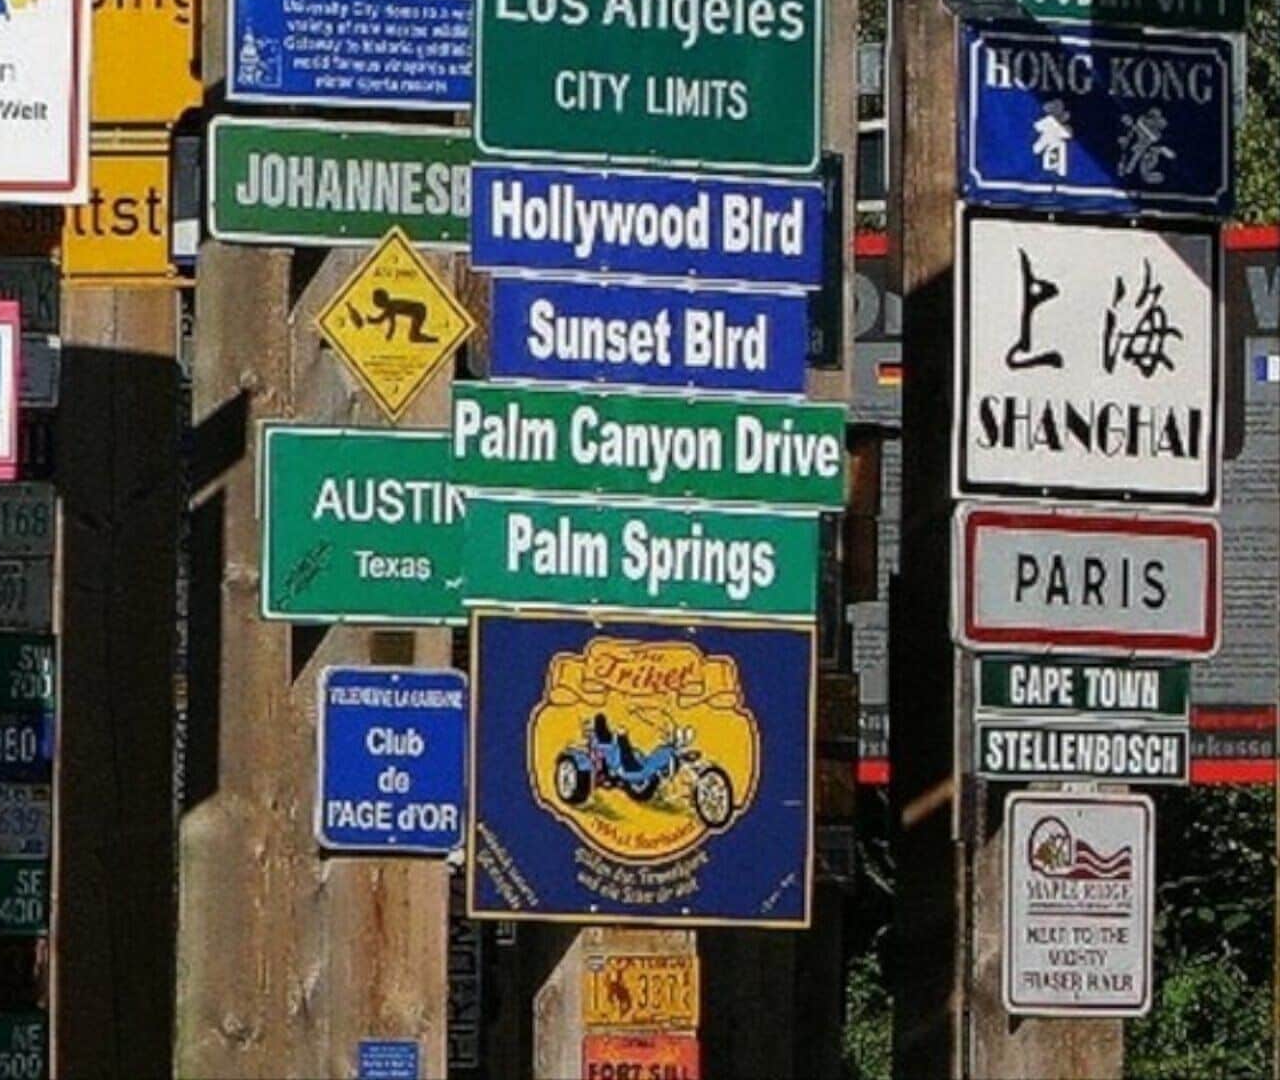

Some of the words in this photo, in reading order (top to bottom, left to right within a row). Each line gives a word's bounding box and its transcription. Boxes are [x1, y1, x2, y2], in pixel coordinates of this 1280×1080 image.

[555, 69, 630, 112] CITY
[646, 75, 747, 121] LIMITS
[985, 47, 1093, 95] HONG
[1109, 58, 1214, 103] KONG
[491, 180, 709, 261] Hollywood
[528, 302, 670, 367] Sunset
[1005, 248, 1184, 377] 上海
[455, 400, 555, 461] Palm
[571, 407, 721, 482] Canyon
[737, 416, 839, 477] Drive
[977, 396, 1202, 460] SHANGHAI
[354, 551, 431, 581] Texas
[507, 514, 607, 575] Palm
[622, 520, 774, 598] Springs
[1015, 553, 1167, 610] PARIS
[1009, 664, 1073, 705] CAPE
[1086, 666, 1160, 710] TOWN
[366, 726, 425, 757] Club
[986, 731, 1178, 774] STELLENBOSCH
[378, 765, 410, 794] de
